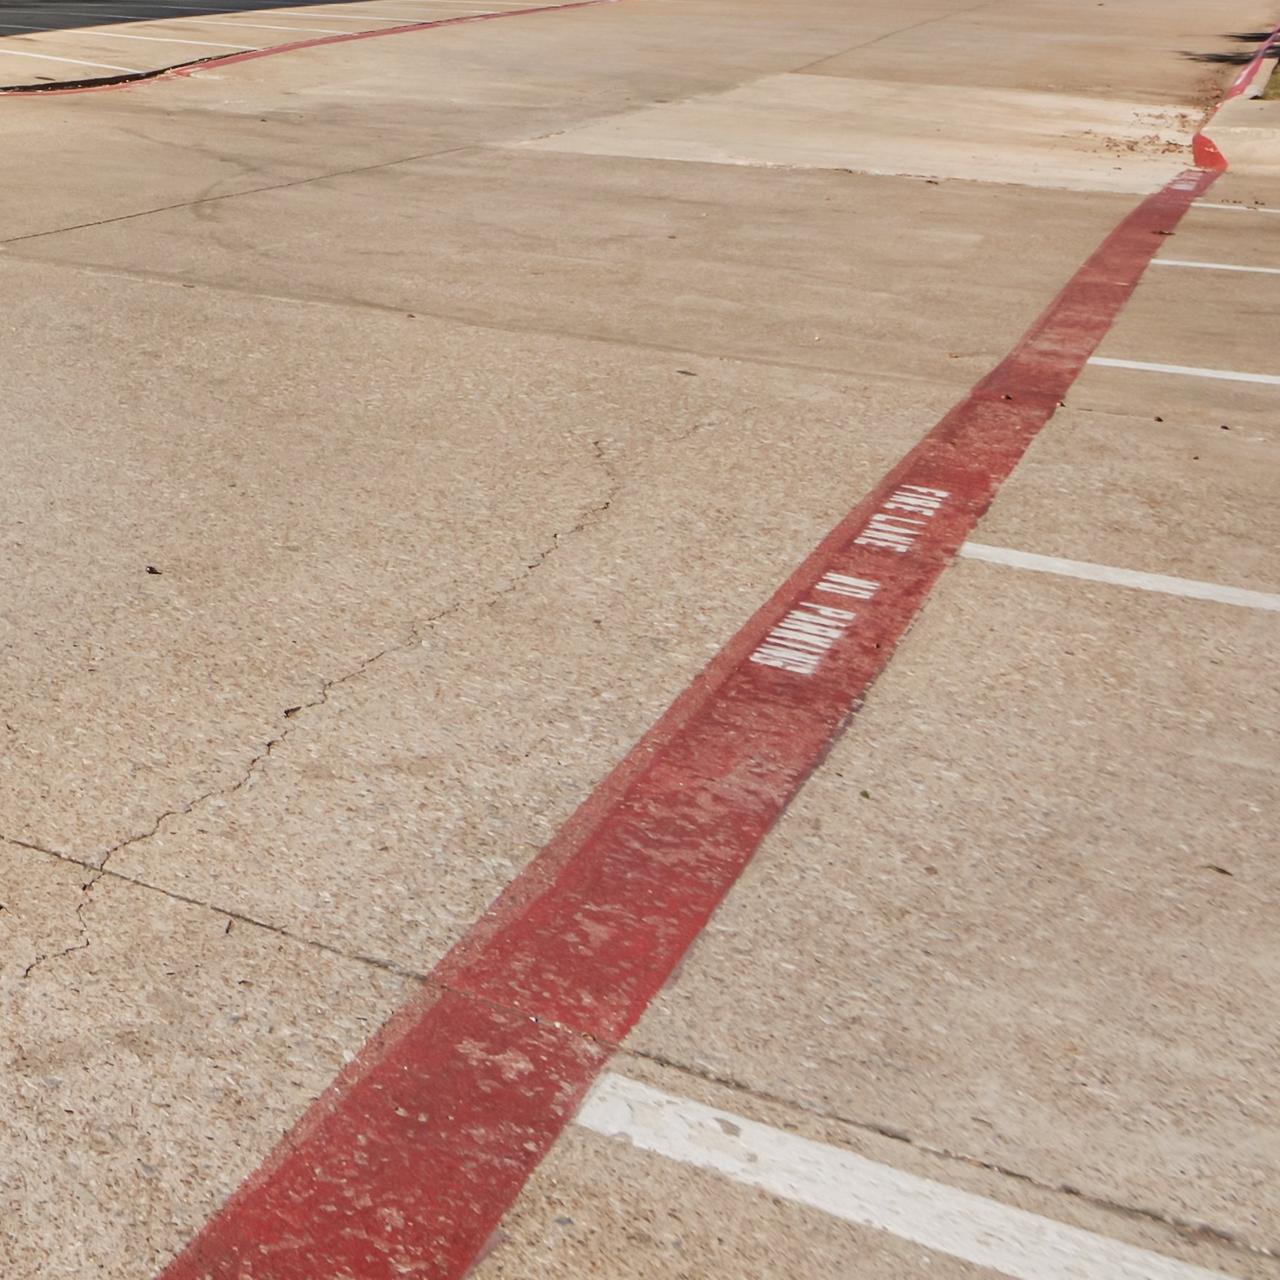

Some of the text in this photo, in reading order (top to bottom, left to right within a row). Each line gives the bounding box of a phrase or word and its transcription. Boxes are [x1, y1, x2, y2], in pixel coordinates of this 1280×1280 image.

[749, 484, 951, 675] FIRE LANE NO PARKING
